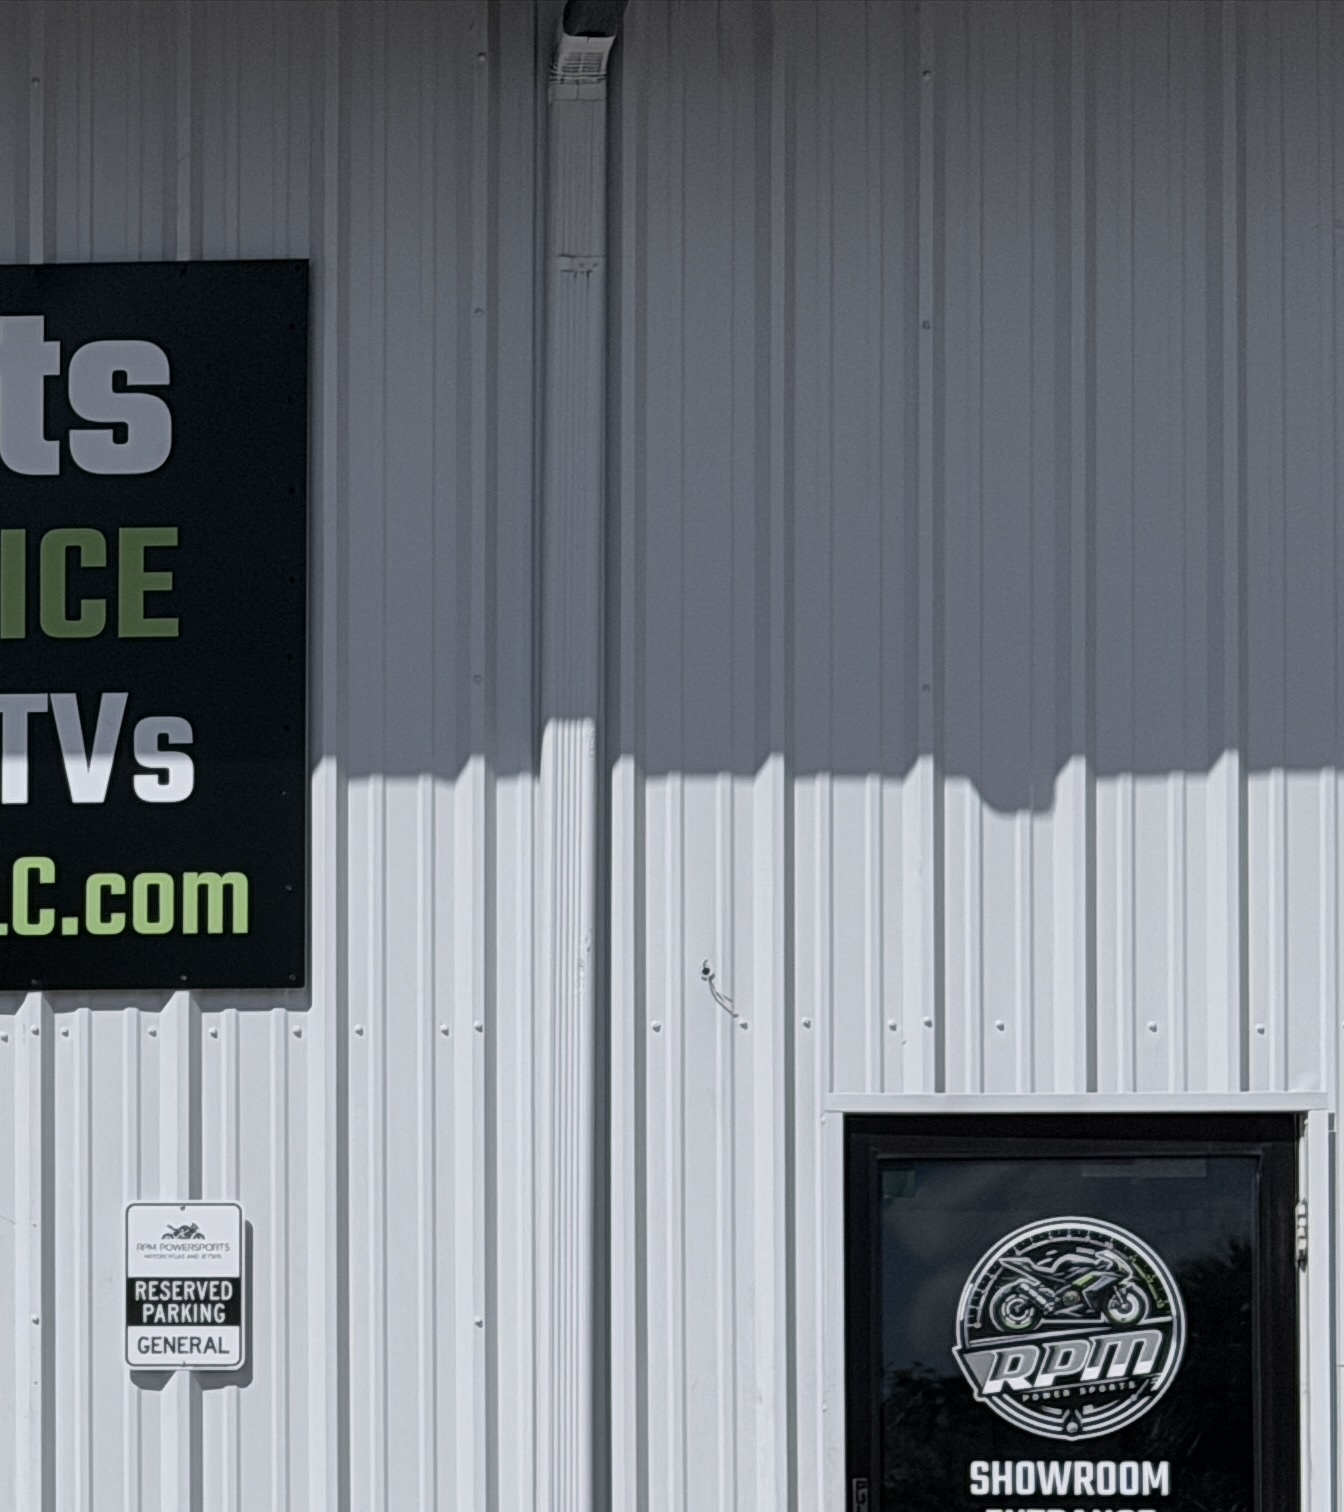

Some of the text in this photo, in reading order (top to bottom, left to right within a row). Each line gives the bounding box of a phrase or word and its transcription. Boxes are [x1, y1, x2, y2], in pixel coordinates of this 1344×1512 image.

[135, 1243, 231, 1251] RPM POWERSPORTS
[134, 1281, 233, 1301] RESERVED
[142, 1303, 226, 1324] PARKING
[137, 1336, 230, 1354] GENERAL
[982, 1329, 1163, 1394] RPM
[969, 1460, 1170, 1496] SHOWROOM
